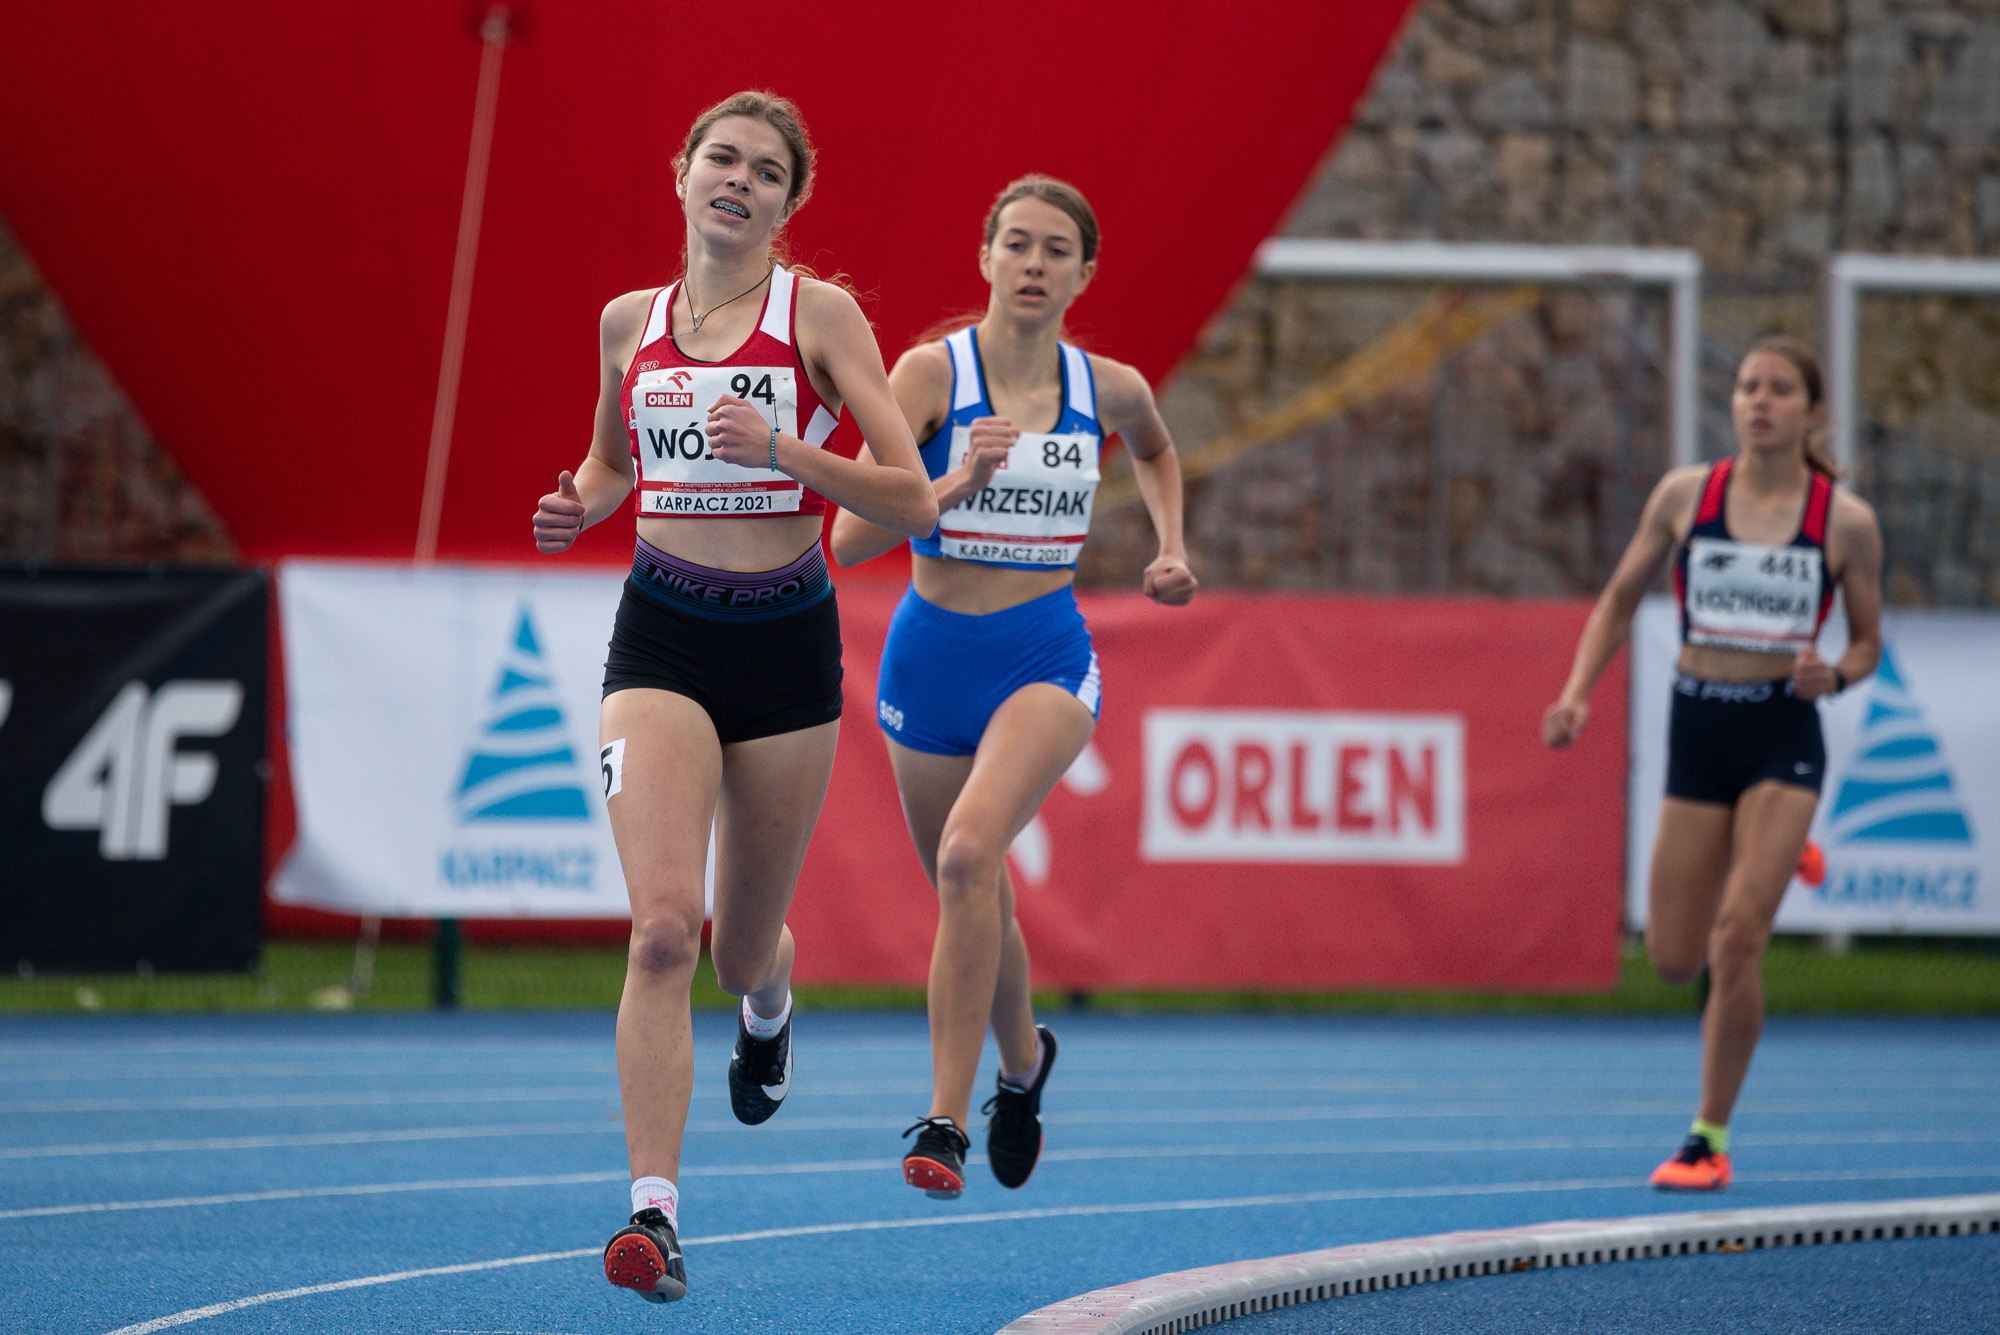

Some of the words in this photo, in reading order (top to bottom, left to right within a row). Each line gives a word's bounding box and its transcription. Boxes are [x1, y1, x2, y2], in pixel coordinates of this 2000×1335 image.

[648, 394, 690, 406] ORLEN
[731, 374, 774, 405] 94
[1043, 441, 1082, 468] 84
[655, 495, 729, 511] KARPACZ
[734, 496, 772, 511] 2021
[959, 544, 1033, 562] KARPACZ
[1036, 550, 1069, 562] 2021
[1760, 555, 1810, 581] 441
[651, 568, 726, 604] NIKE
[730, 580, 800, 606] PRO
[43, 680, 243, 860] 4F
[1168, 741, 1437, 834] ORLEN
